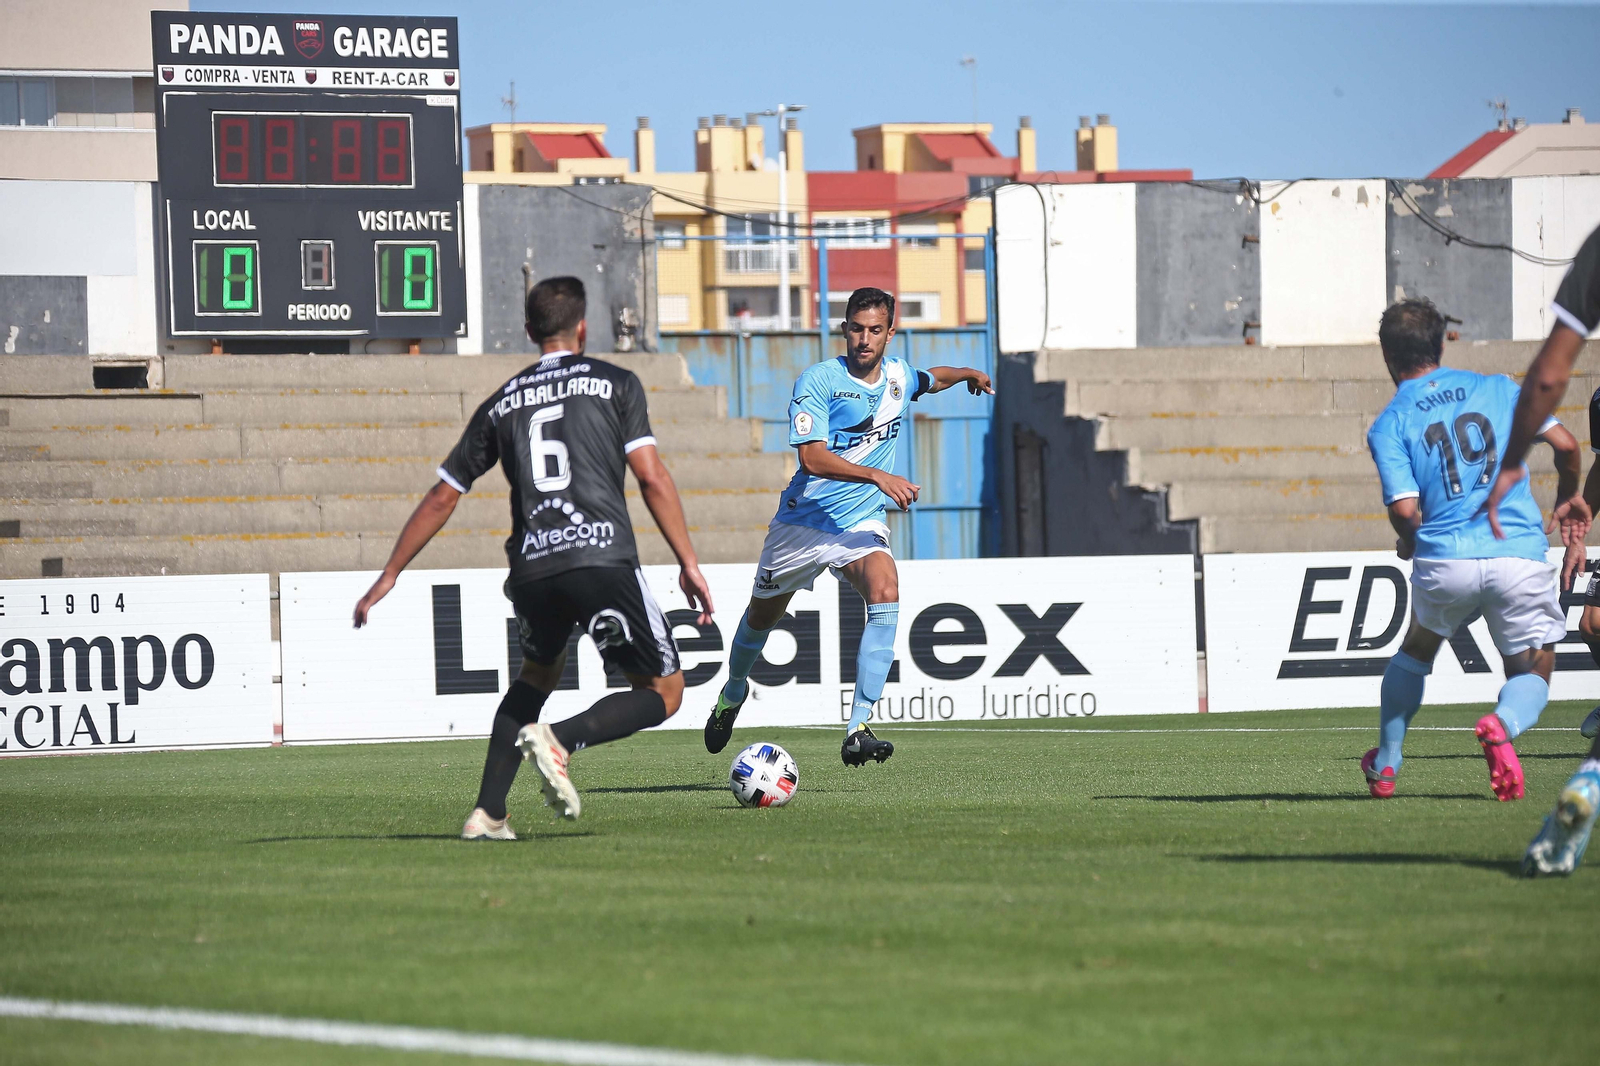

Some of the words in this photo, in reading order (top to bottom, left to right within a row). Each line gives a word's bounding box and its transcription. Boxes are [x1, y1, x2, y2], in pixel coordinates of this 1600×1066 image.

[295, 23, 320, 31] PANDA
[169, 23, 285, 56] PANDA
[333, 26, 449, 59] GARAGE
[184, 68, 241, 83] COMPRA
[252, 69, 296, 84] VENTA
[332, 71, 429, 86] RENT-A-CAR
[192, 209, 256, 230] LOCAL
[357, 210, 453, 232] VISITANTE
[287, 303, 352, 321] PERIODO
[518, 363, 591, 386] SANTELMO
[523, 376, 613, 407] BALLARDO
[833, 391, 861, 400] LEGEA
[1415, 387, 1467, 412] CHIRO
[528, 403, 572, 493] 6
[1421, 411, 1498, 502] 19
[520, 521, 615, 554] Airecom
[756, 582, 780, 590] LEGEA
[980, 684, 1098, 719] Jurídico
[0, 702, 136, 749] CIAL
